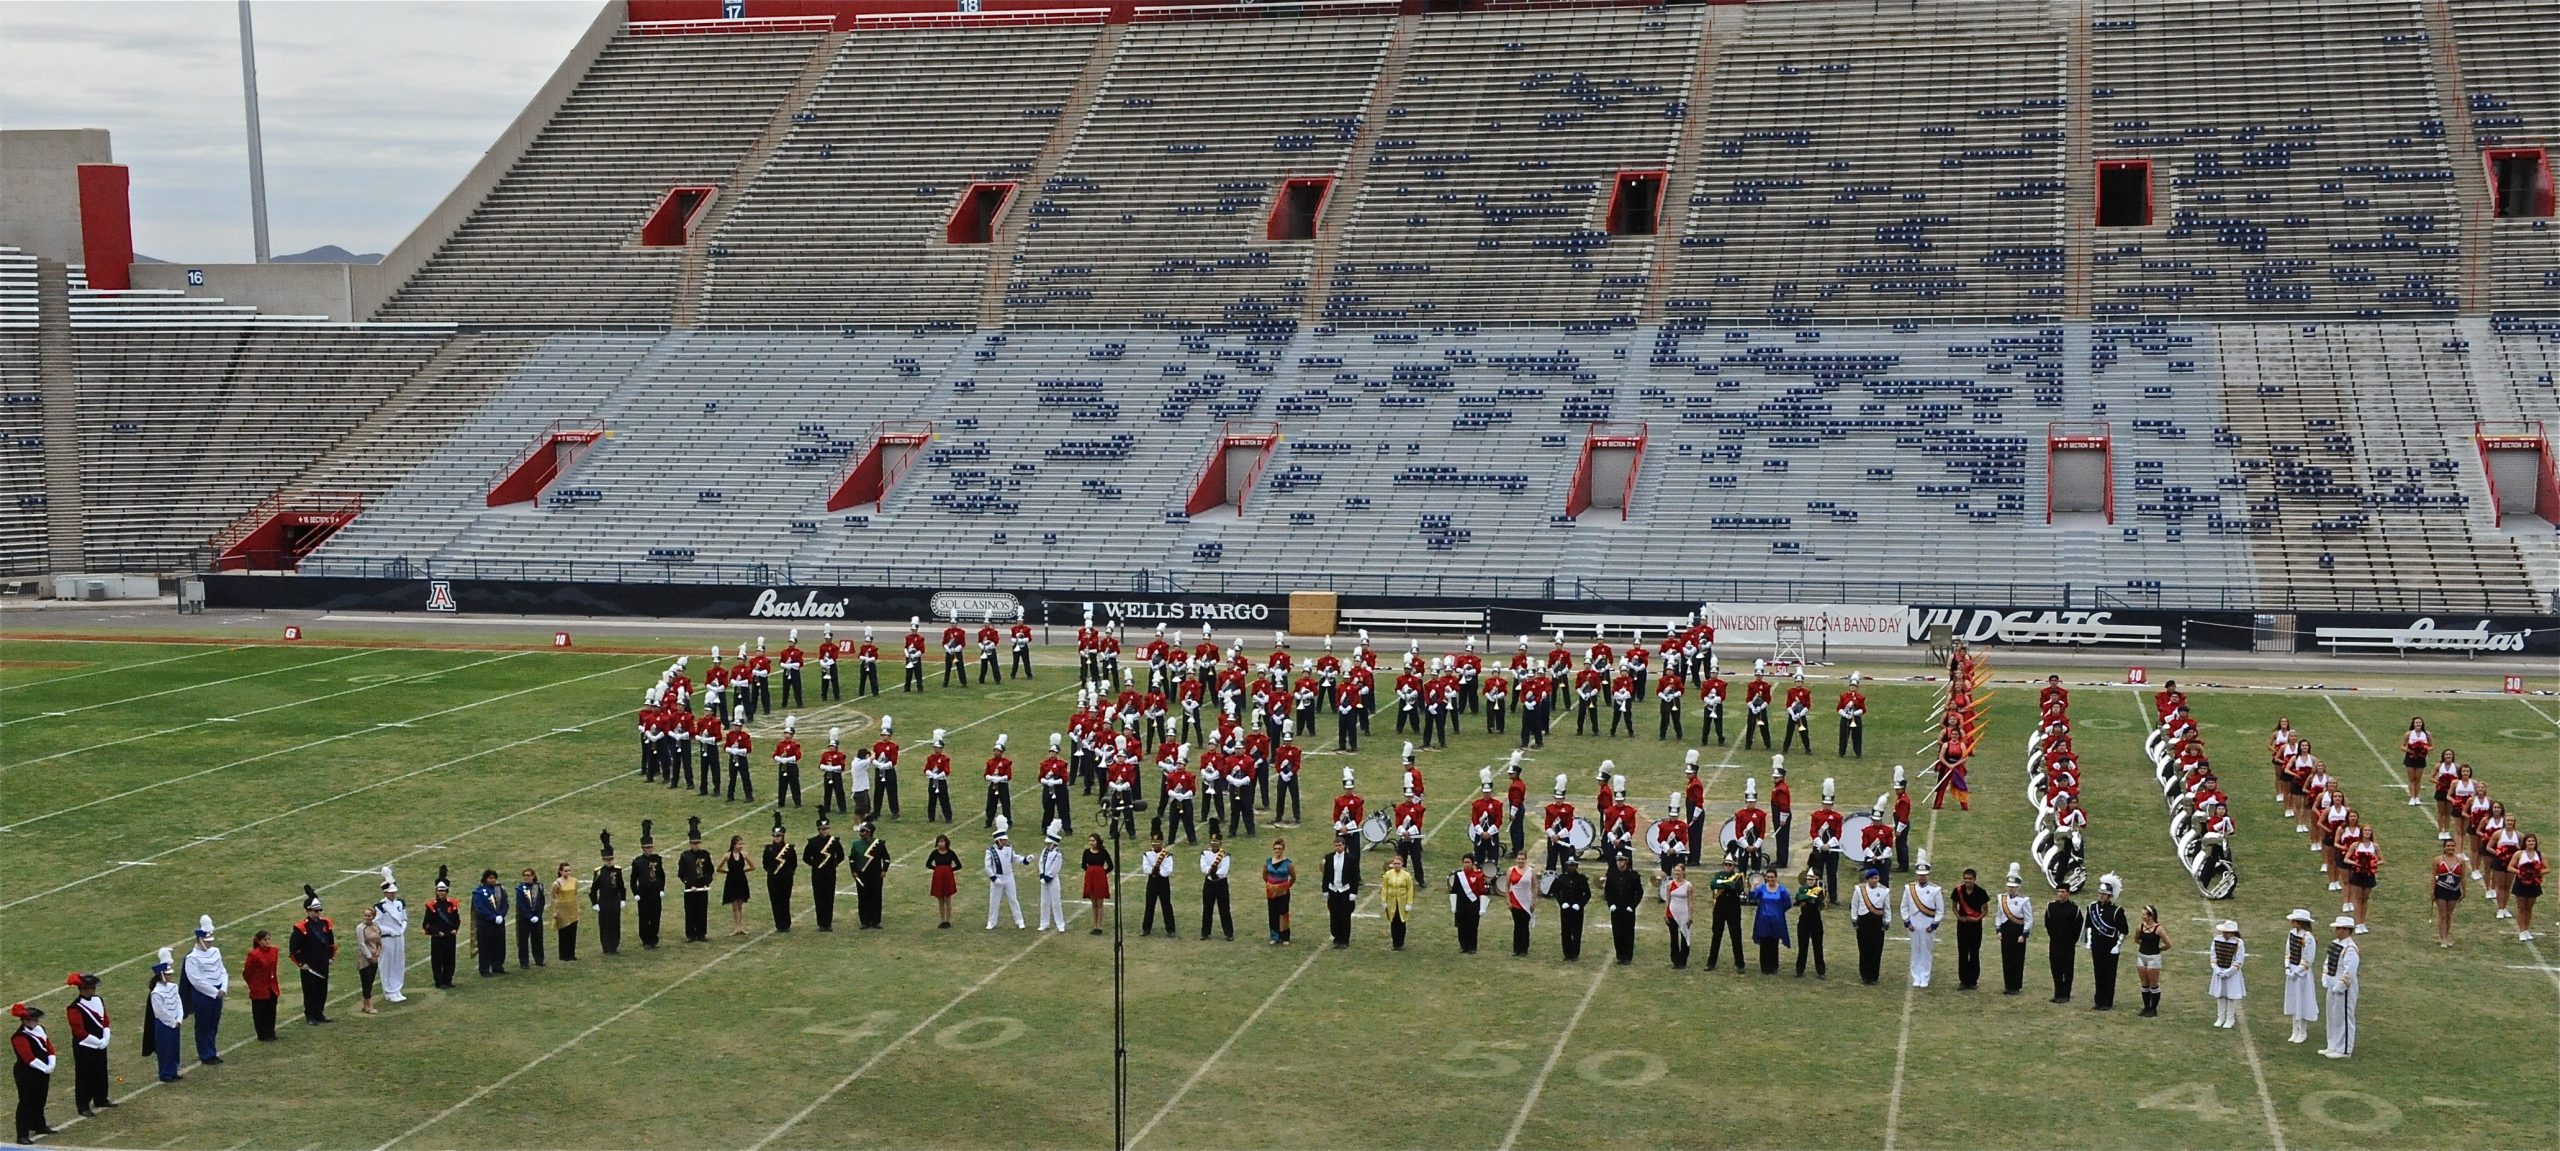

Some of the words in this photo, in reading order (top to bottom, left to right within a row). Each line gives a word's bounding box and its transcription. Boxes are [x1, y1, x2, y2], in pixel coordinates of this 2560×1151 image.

[726, 5, 742, 18] 17
[961, 0, 978, 12] 18
[188, 271, 203, 284] 16
[426, 581, 456, 611] A
[750, 589, 849, 617] Bashas'
[940, 600, 960, 609] SOL
[963, 600, 1010, 610] CASINOS
[1103, 602, 1184, 619] WELLS
[1189, 603, 1269, 620] FARGO
[1711, 615, 1771, 631] UNIVERSITY
[1790, 616, 1841, 632] RIZONA
[1844, 617, 1876, 633] BAND
[1879, 617, 1902, 633] DAY
[285, 628, 297, 638] G
[556, 634, 566, 645] 10
[840, 641, 851, 652] 20
[1136, 647, 1148, 658] 30
[1777, 665, 1787, 675] 50
[2129, 669, 2142, 681] 40
[2507, 677, 2520, 690] 30
[799, 1010, 1028, 1050] 40
[1430, 1040, 1669, 1087] 50
[2137, 1082, 2403, 1132] 40
